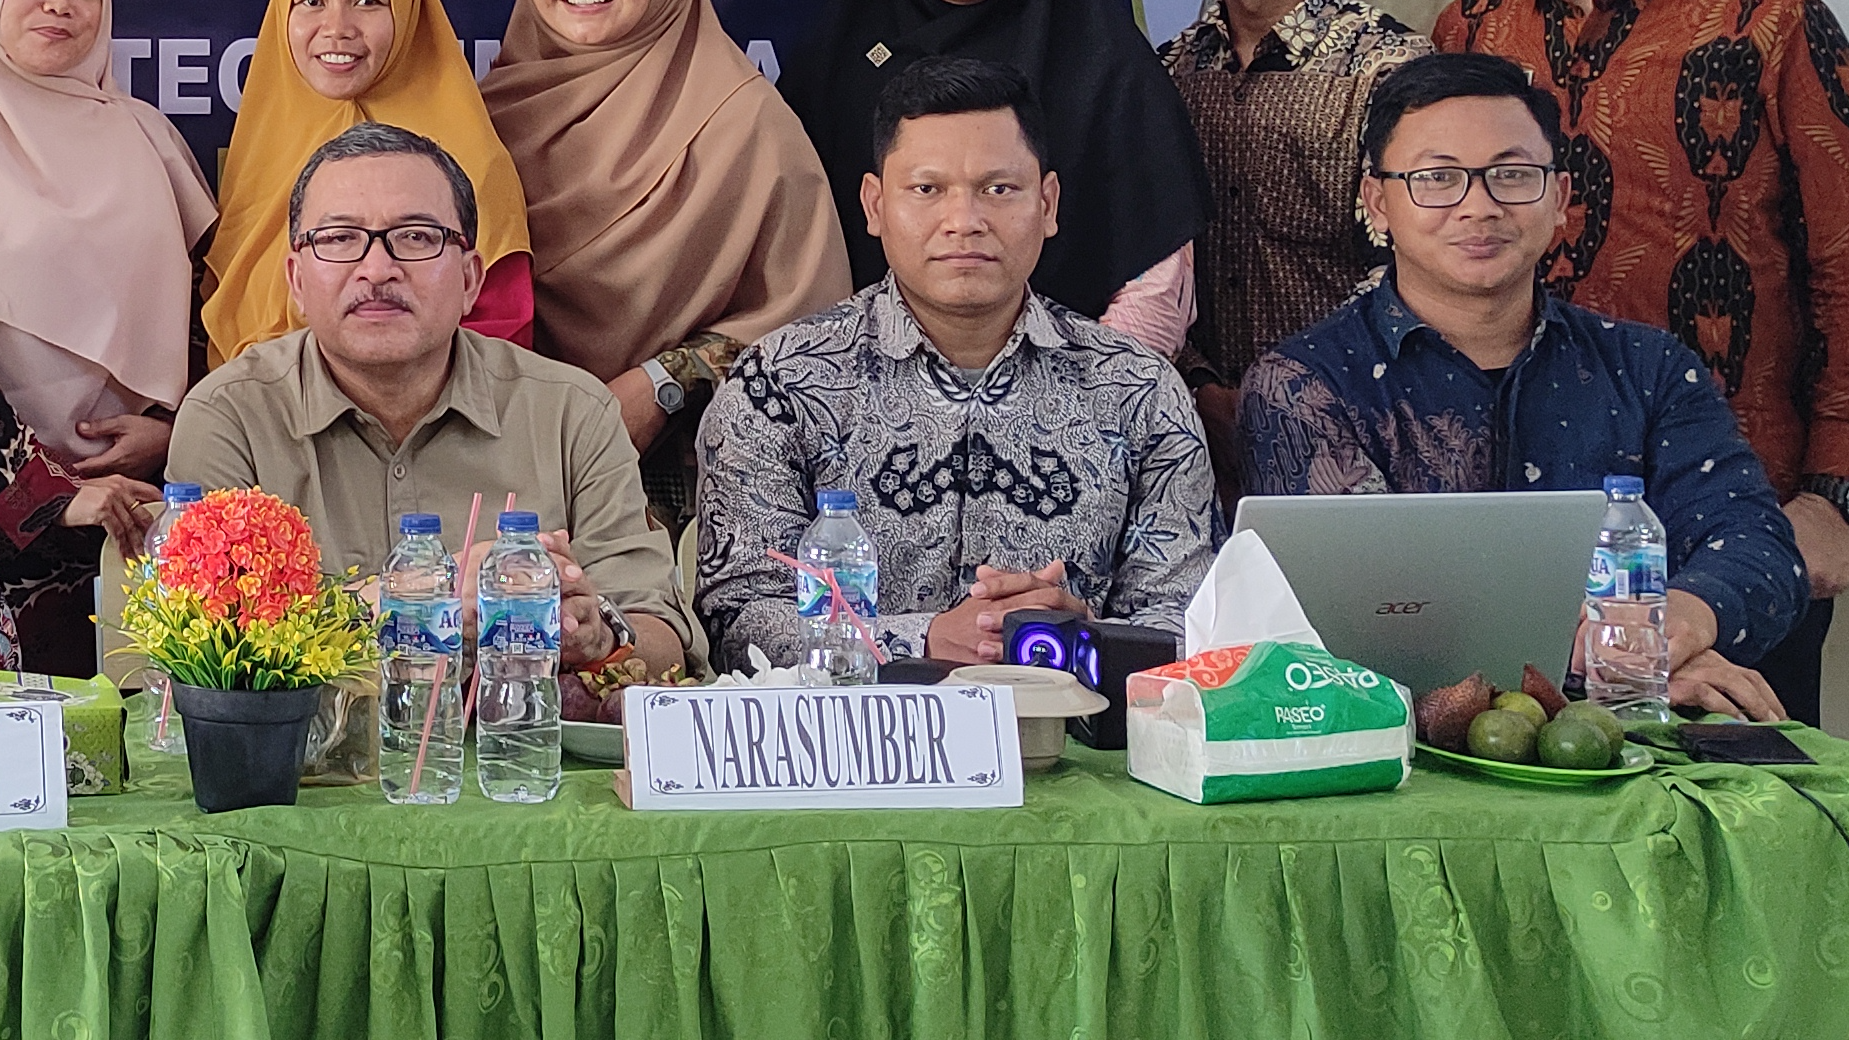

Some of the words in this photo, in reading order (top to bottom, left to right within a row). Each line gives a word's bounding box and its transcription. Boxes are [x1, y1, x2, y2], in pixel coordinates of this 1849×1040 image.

[1375, 601, 1431, 615] acer
[1275, 705, 1325, 723] PASEO
[688, 692, 955, 790] NARASUMBER
